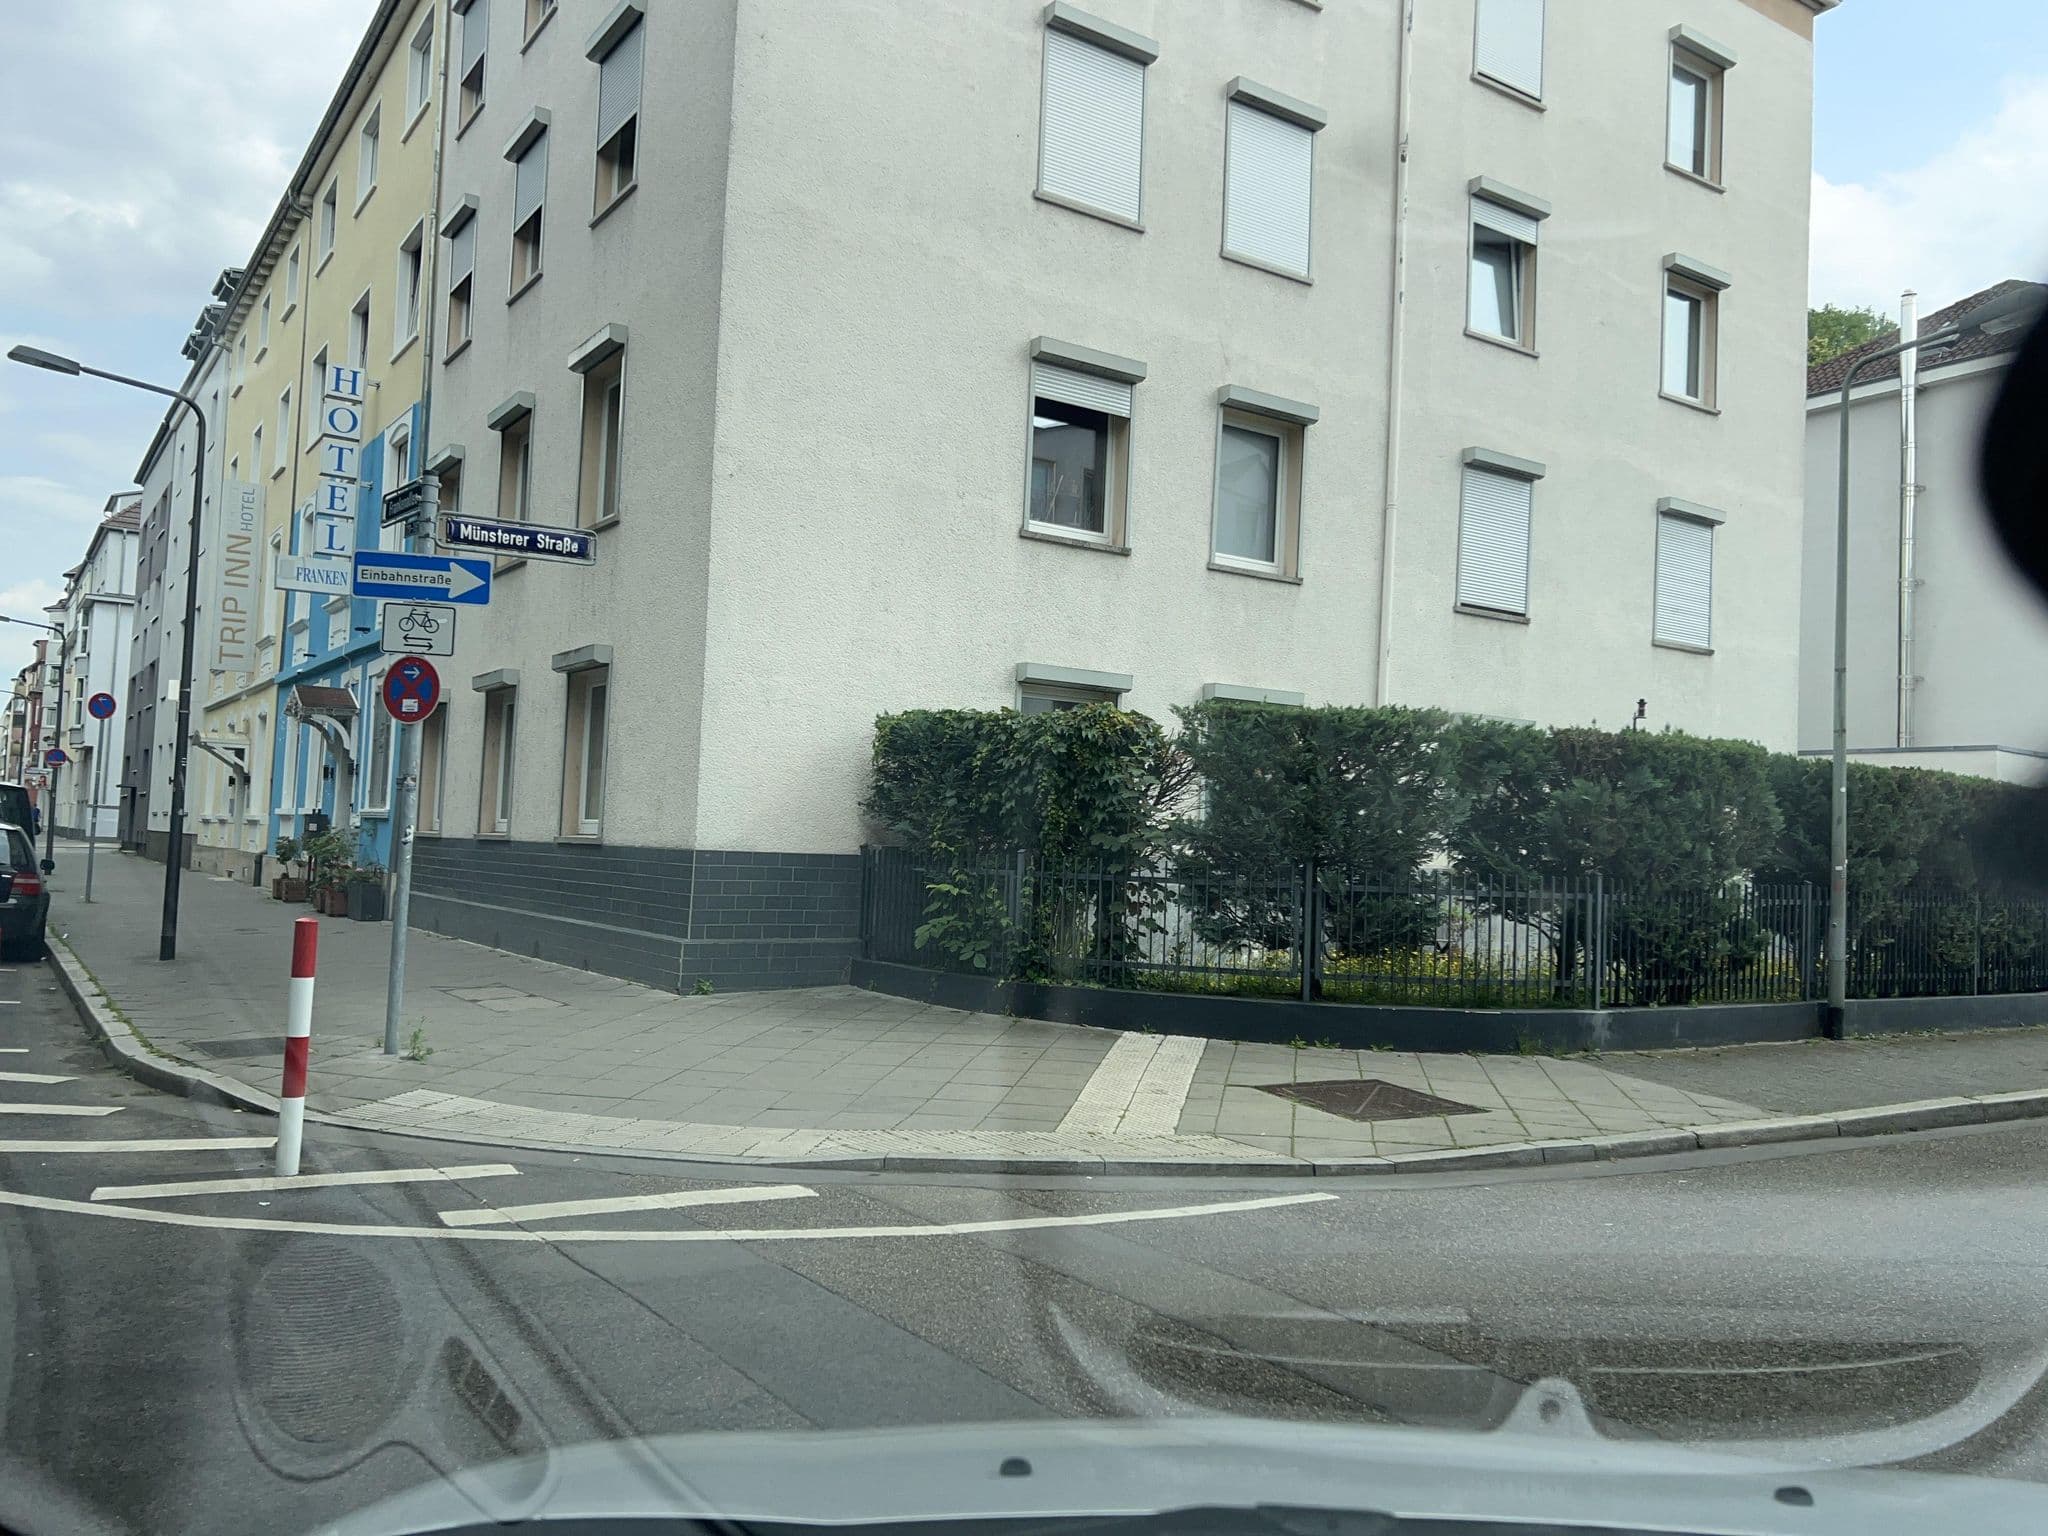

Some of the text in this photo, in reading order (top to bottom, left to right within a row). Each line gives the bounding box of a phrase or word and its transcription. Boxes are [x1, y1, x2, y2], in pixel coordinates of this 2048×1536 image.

[325, 366, 361, 551] HOTEL
[240, 488, 255, 532] HOTEL
[459, 523, 579, 554] Münsterer Straße
[296, 566, 348, 586] FRANKEN
[360, 568, 452, 586] Einbahnstraße
[219, 533, 252, 664] TRIP INN
